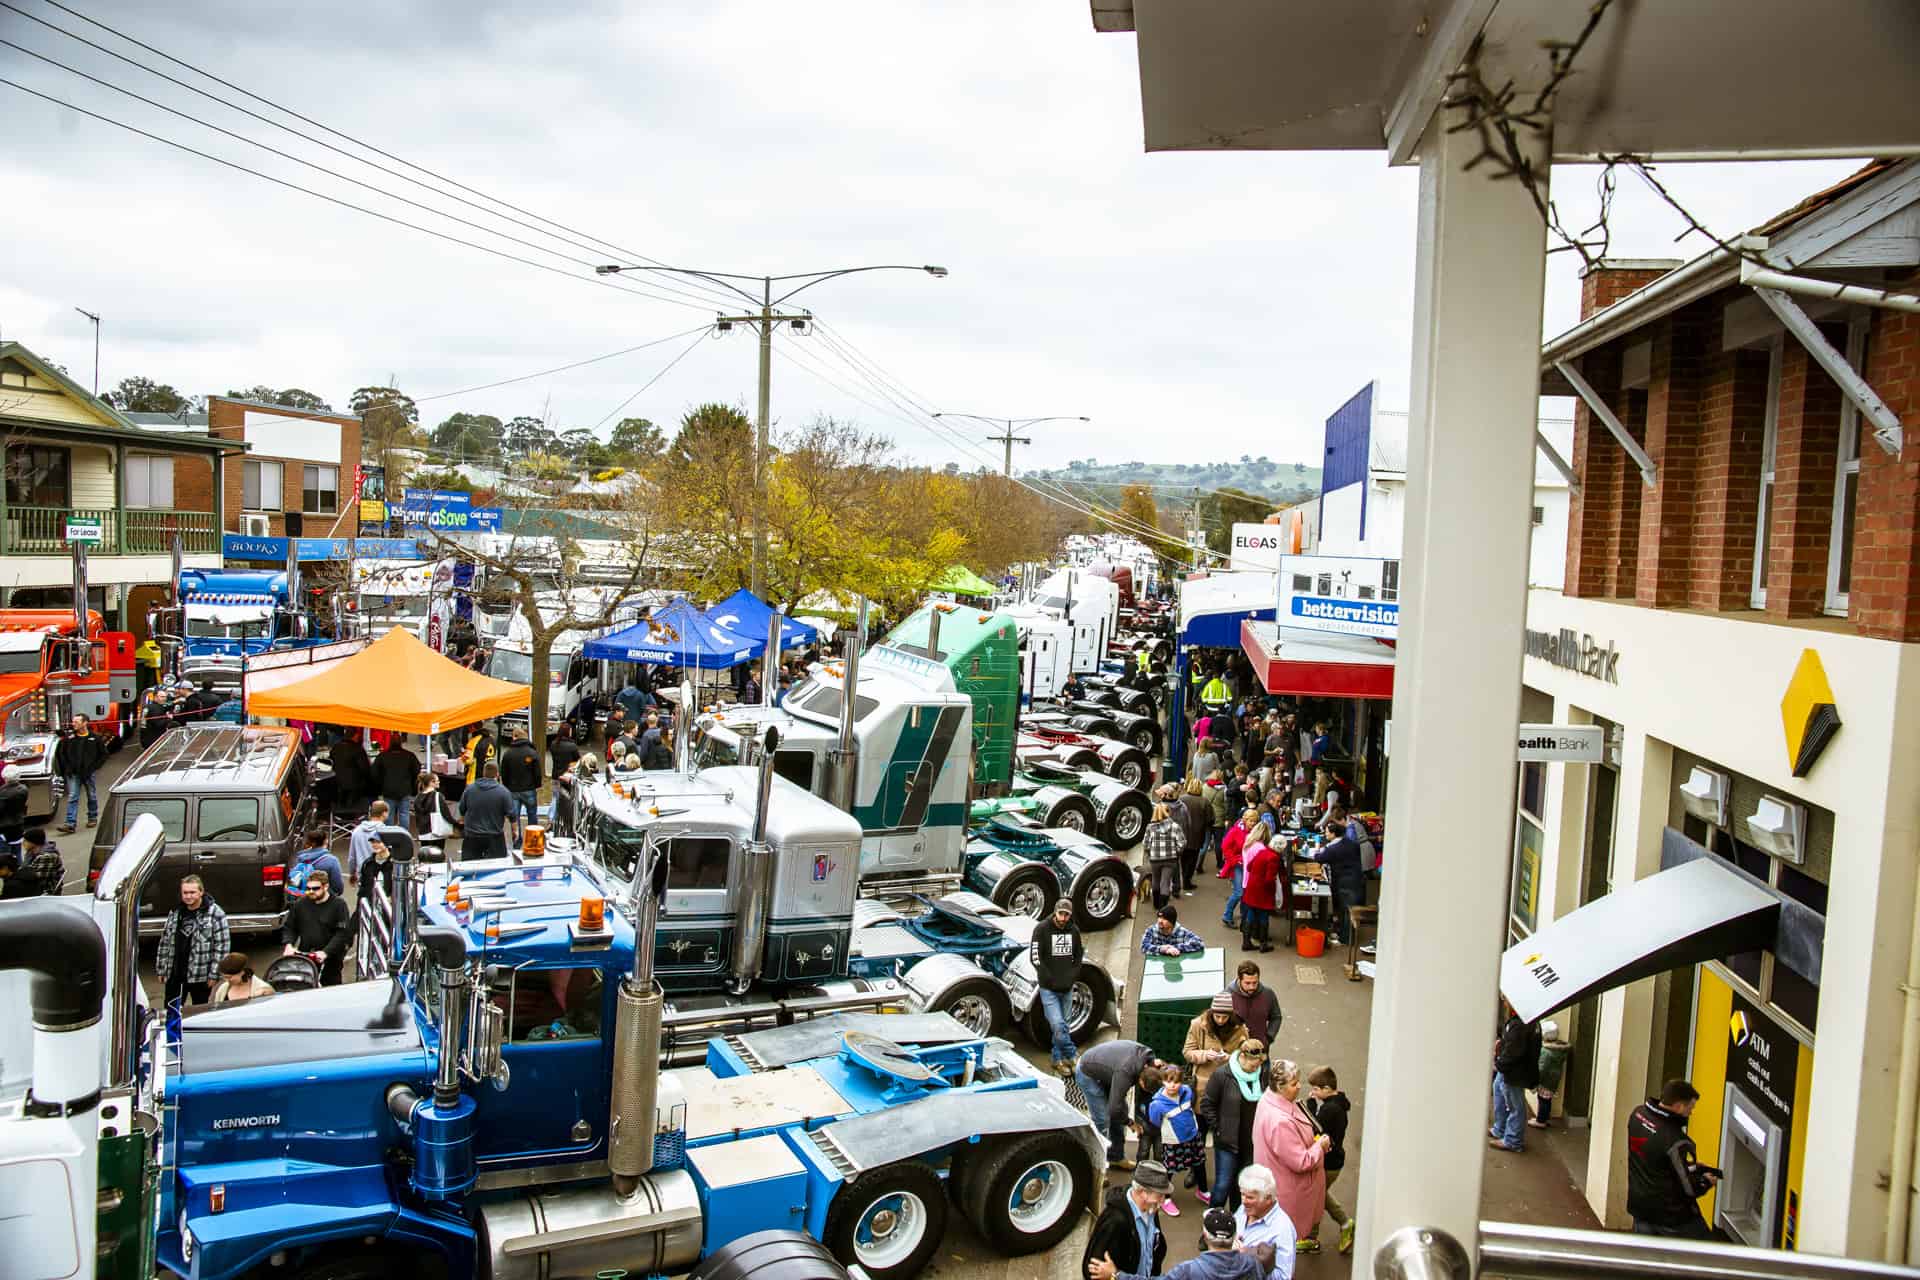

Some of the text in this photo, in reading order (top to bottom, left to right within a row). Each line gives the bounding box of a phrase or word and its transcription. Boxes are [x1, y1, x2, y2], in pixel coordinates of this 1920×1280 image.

[71, 527, 98, 536] For Lease
[231, 541, 279, 555] BOOKS
[1236, 536, 1278, 549] ELGAS
[1580, 633, 1619, 686] Bank
[1559, 738, 1590, 750] Bank
[1531, 963, 1560, 988] ATM
[1749, 1031, 1771, 1061] ATM
[213, 1114, 281, 1129] KENWORTH
